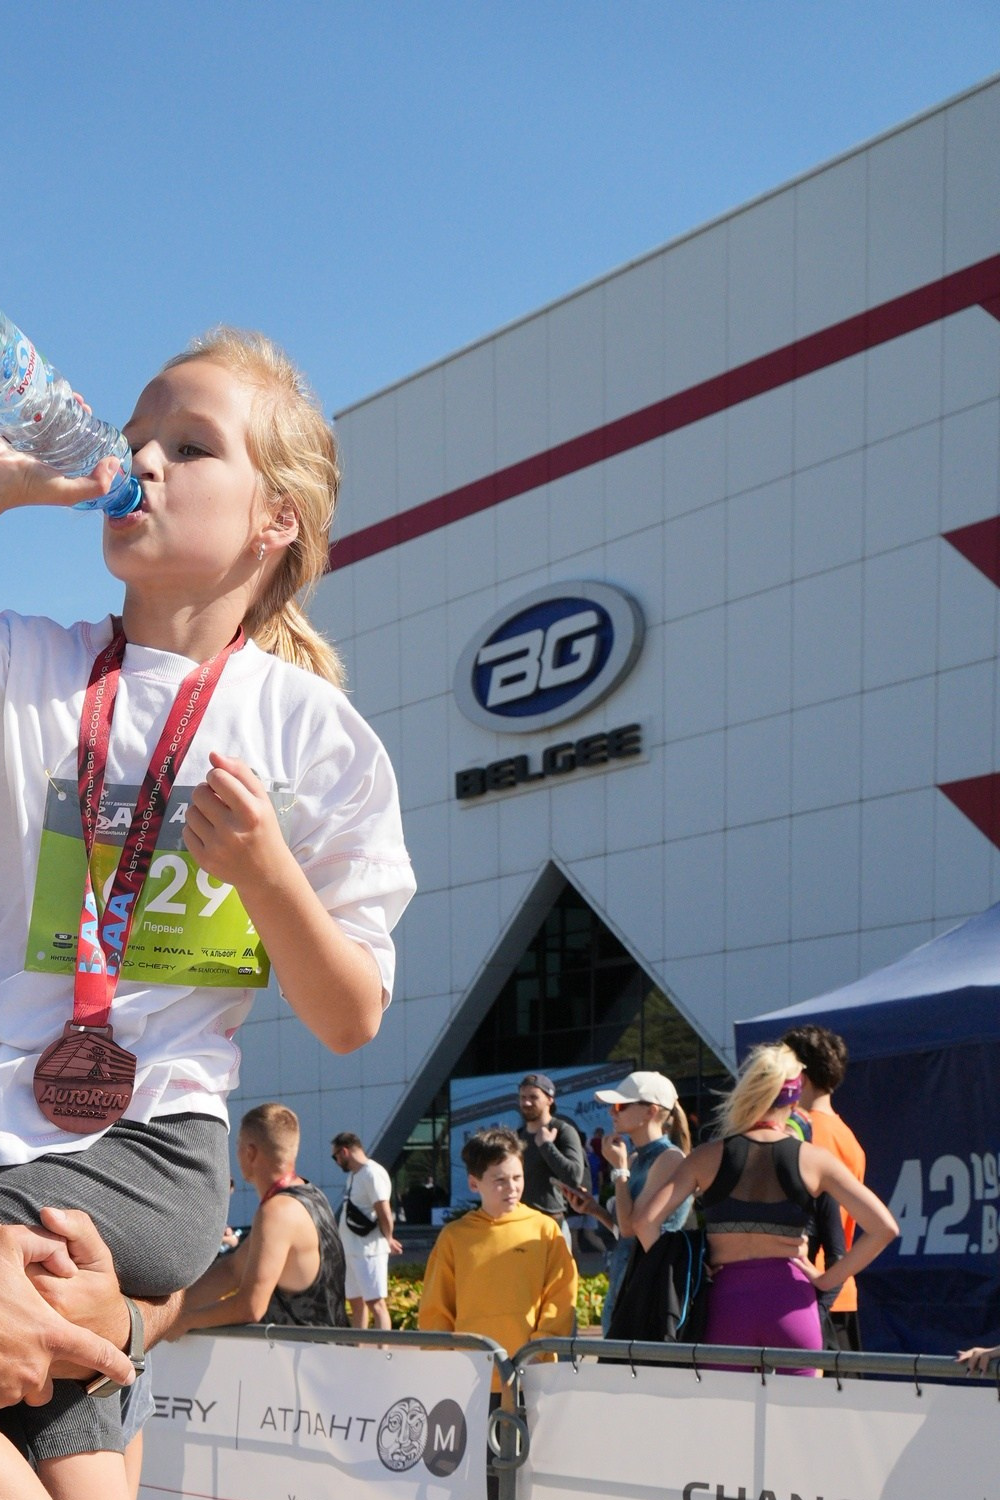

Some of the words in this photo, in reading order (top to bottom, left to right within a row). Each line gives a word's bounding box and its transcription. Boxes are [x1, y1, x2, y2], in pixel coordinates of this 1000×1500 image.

[477, 610, 599, 708] BG
[124, 755, 173, 882] Автомобильная
[169, 666, 211, 752] ассоциация
[455, 722, 642, 800] BELGEE
[103, 854, 234, 917] 29
[143, 921, 184, 934] Первые
[138, 962, 177, 971] CHERY
[153, 946, 194, 956] HAVAL
[151, 1396, 218, 1423] ERY
[260, 1406, 376, 1443] АТЛАНТ
